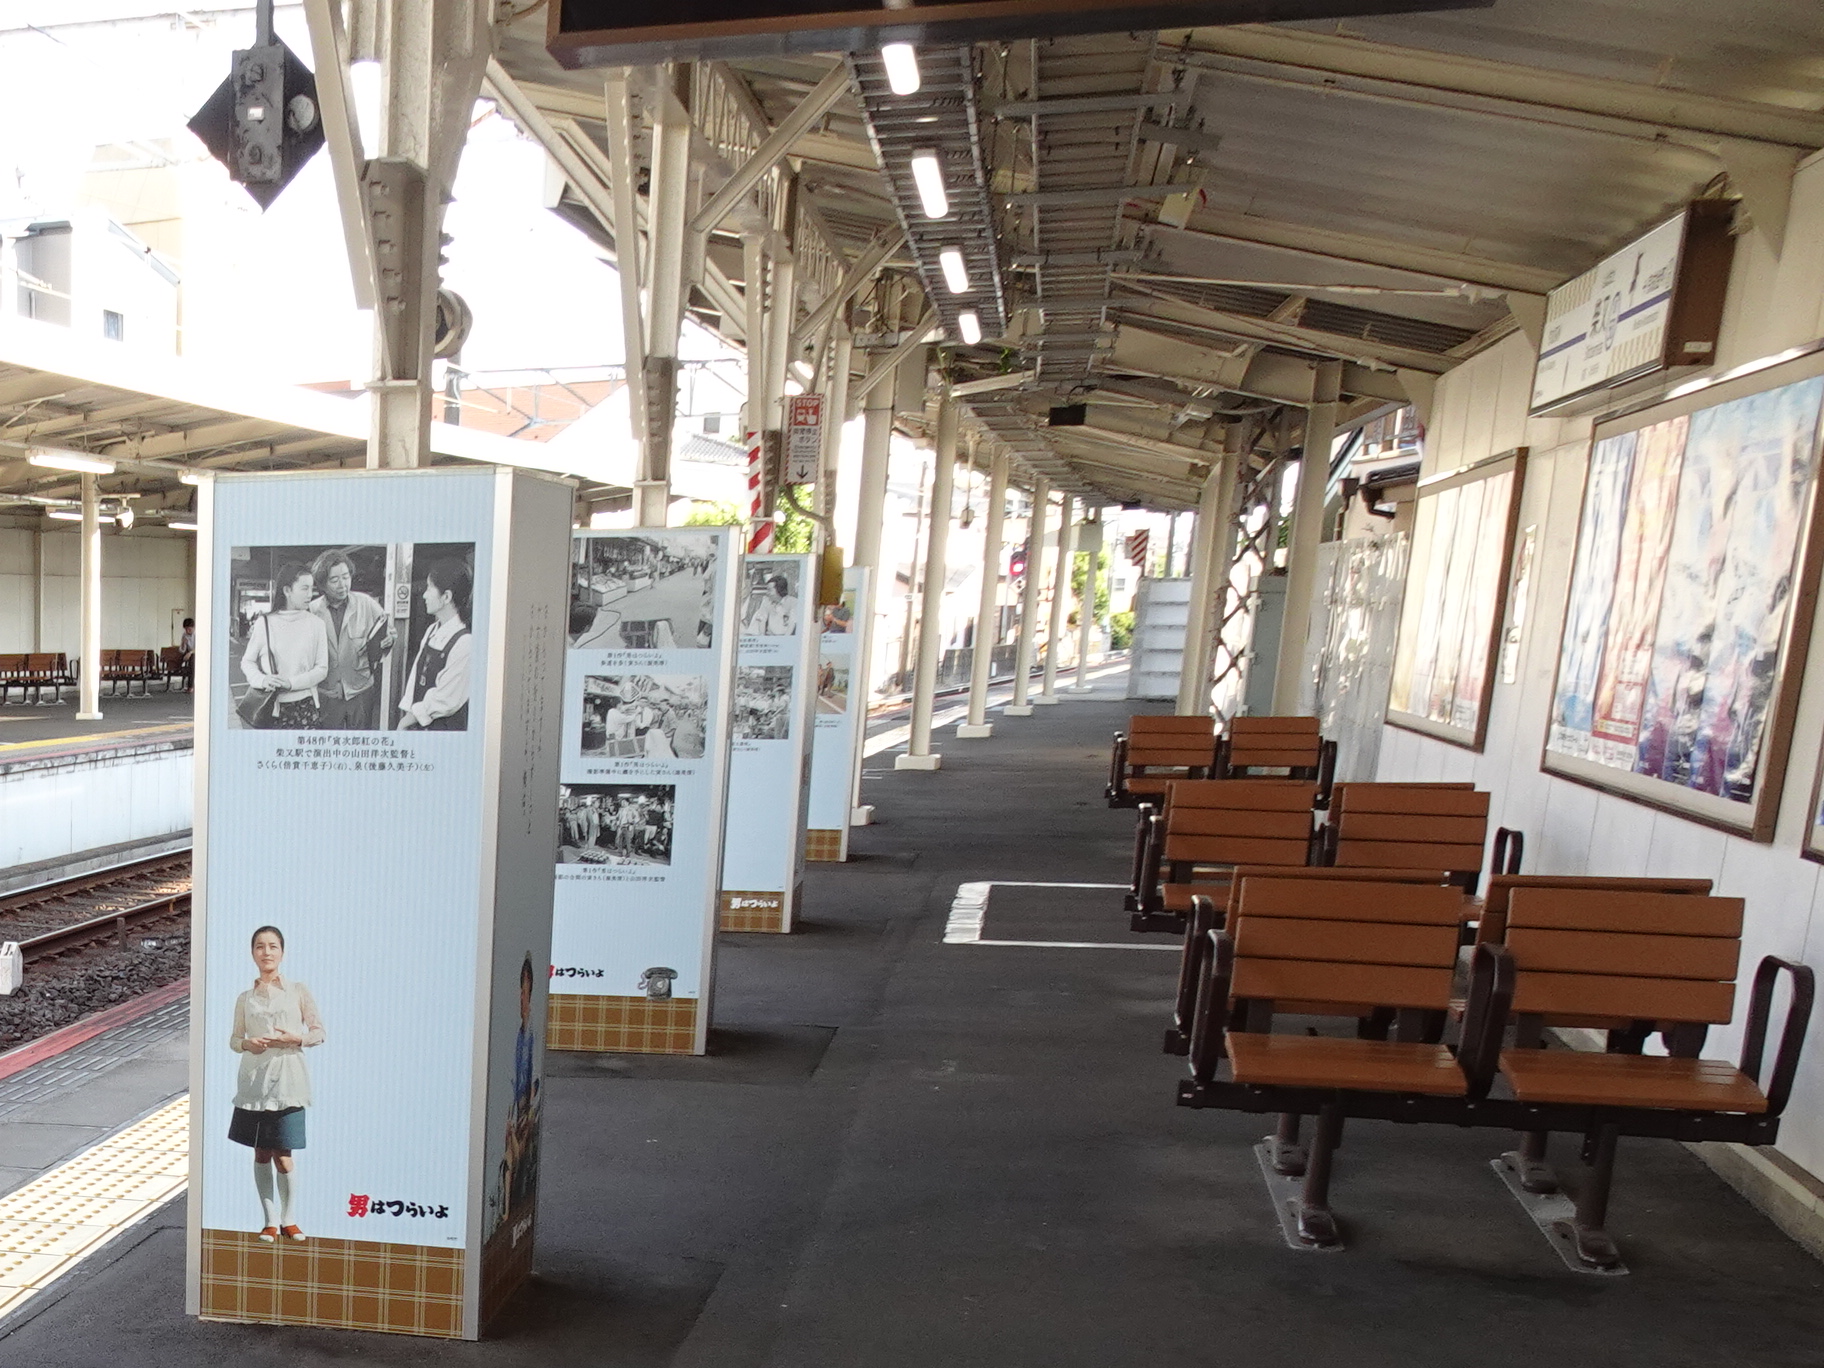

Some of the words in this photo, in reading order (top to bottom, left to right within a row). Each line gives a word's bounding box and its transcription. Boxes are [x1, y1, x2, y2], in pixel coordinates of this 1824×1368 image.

[297, 735, 395, 747] 第48作『寅次郎紅の花』
[276, 748, 416, 759] 柴又駅で演出中の山田洋次監督と
[550, 964, 605, 978] はつらいよ
[346, 1192, 449, 1219] 男はつらいよ
